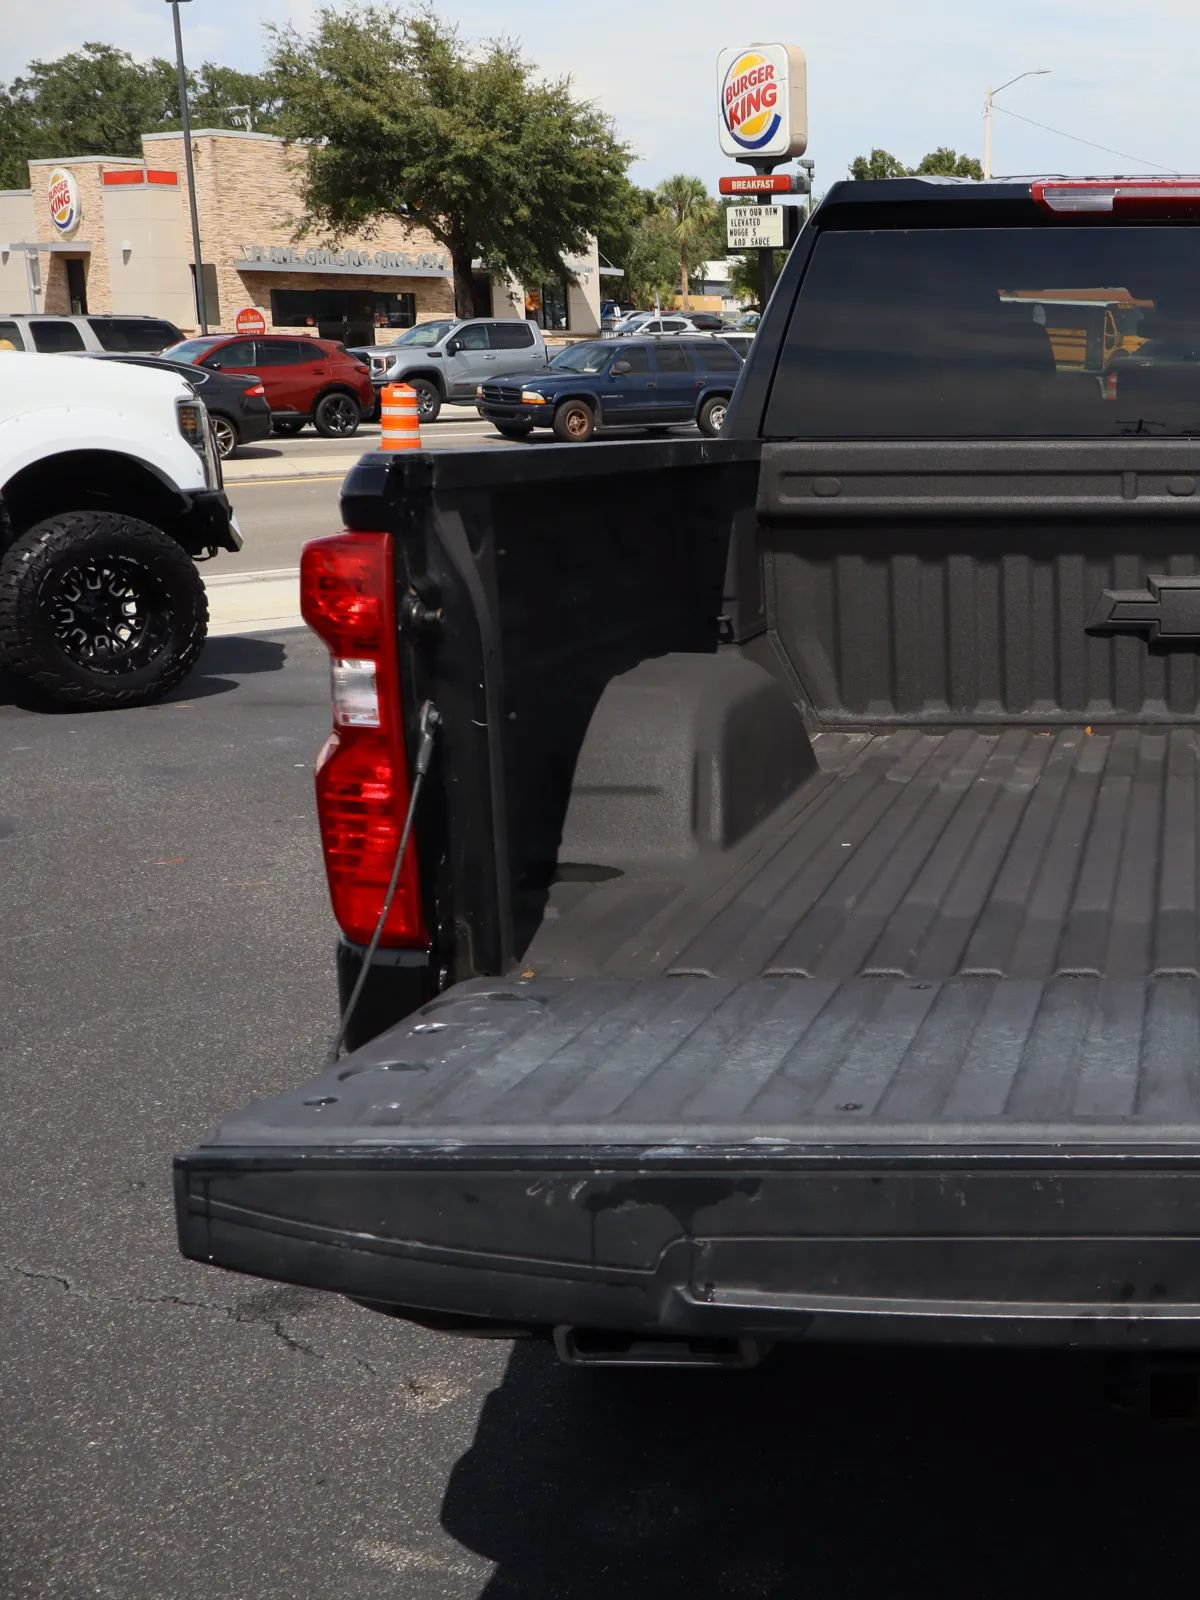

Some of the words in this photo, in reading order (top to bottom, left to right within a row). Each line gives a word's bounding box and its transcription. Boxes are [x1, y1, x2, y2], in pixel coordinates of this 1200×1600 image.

[726, 64, 774, 106] BURGER
[729, 83, 777, 131] KING
[731, 180, 774, 190] BREAKFAST
[51, 190, 70, 214] KING
[735, 209, 747, 217] TRY
[750, 208, 762, 216] OUR
[731, 218, 760, 227] ELEVATED
[751, 237, 770, 246] SAUCE
[305, 248, 369, 267] GRILLING
[375, 251, 410, 268] SINCE
